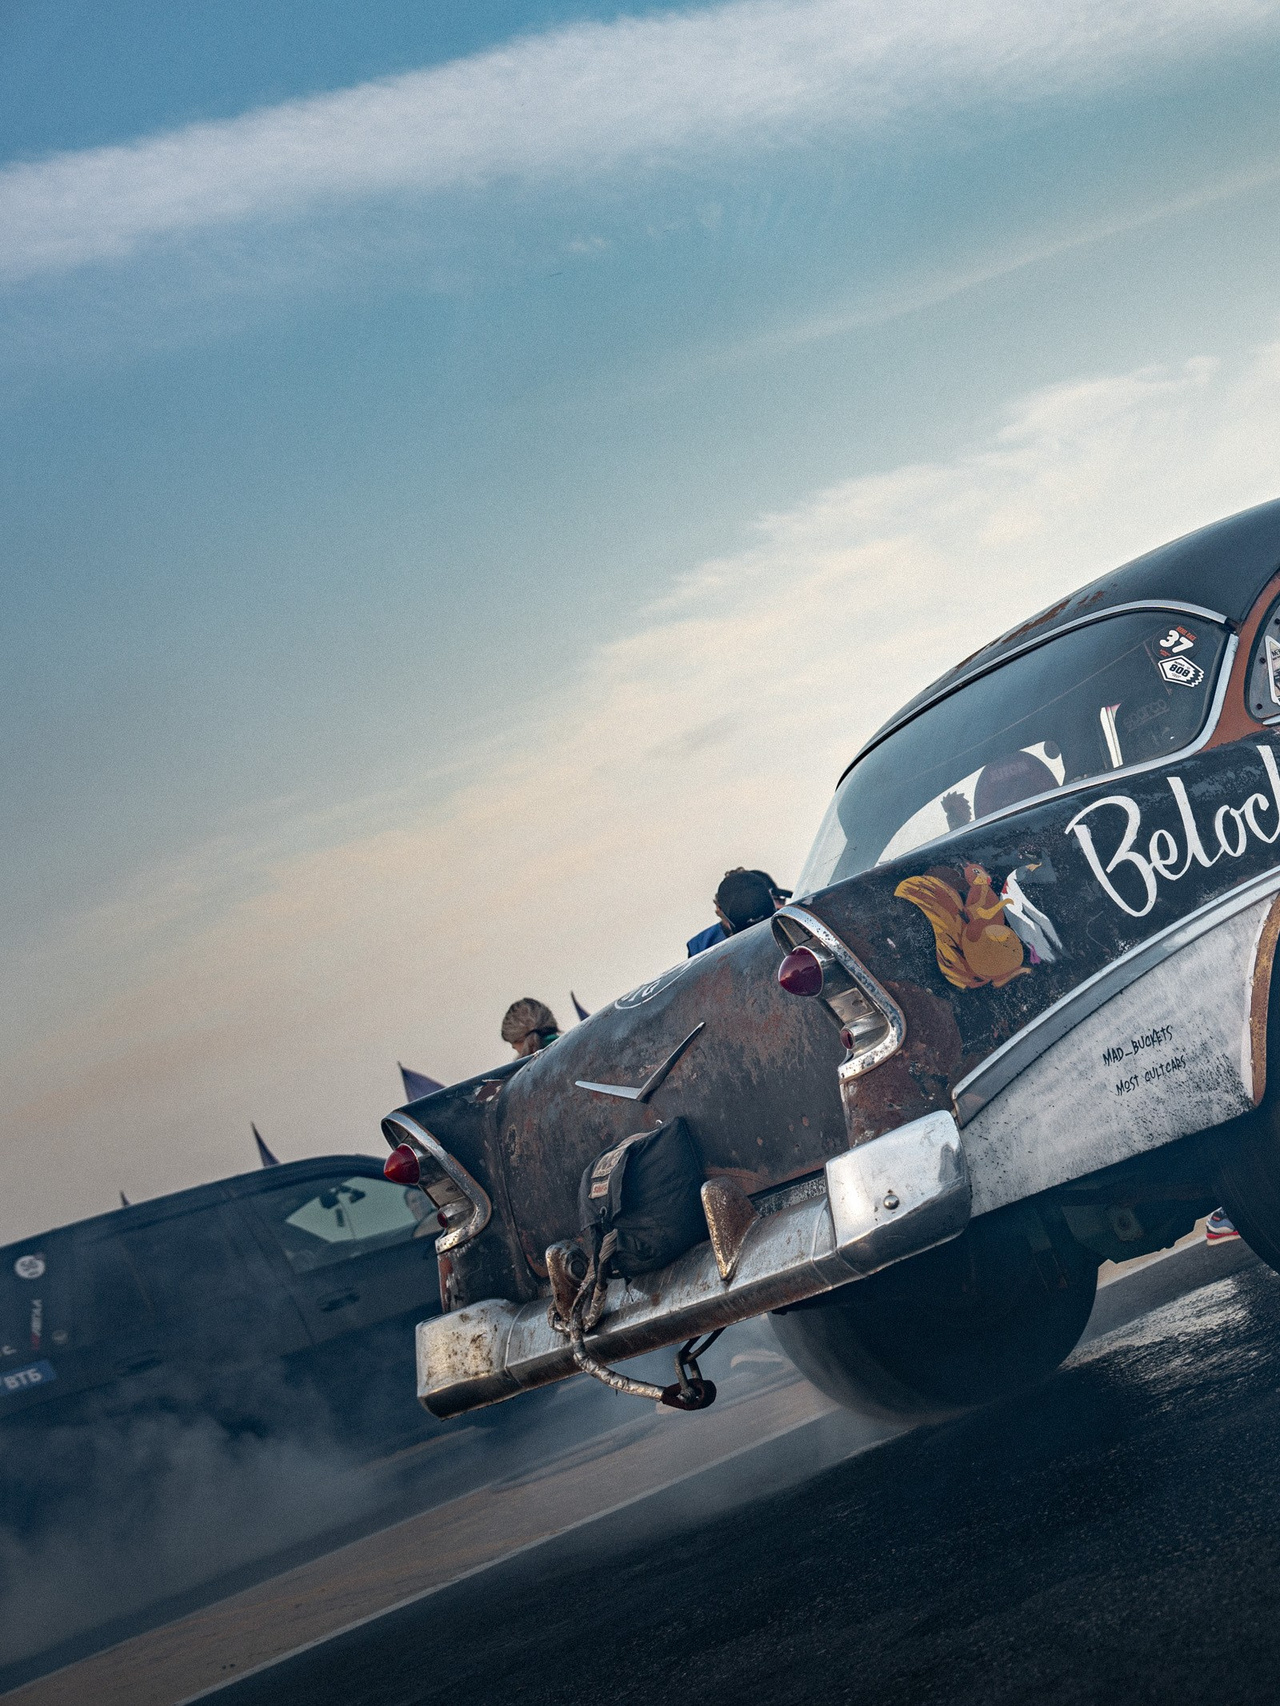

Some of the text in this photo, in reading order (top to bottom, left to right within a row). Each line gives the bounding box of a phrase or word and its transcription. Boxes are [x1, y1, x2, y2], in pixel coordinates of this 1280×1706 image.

[1160, 630, 1194, 653] 37
[1169, 664, 1191, 677] 808
[1103, 1025, 1173, 1066] MAD_BUCKETS
[1116, 1074, 1139, 1096] MOST
